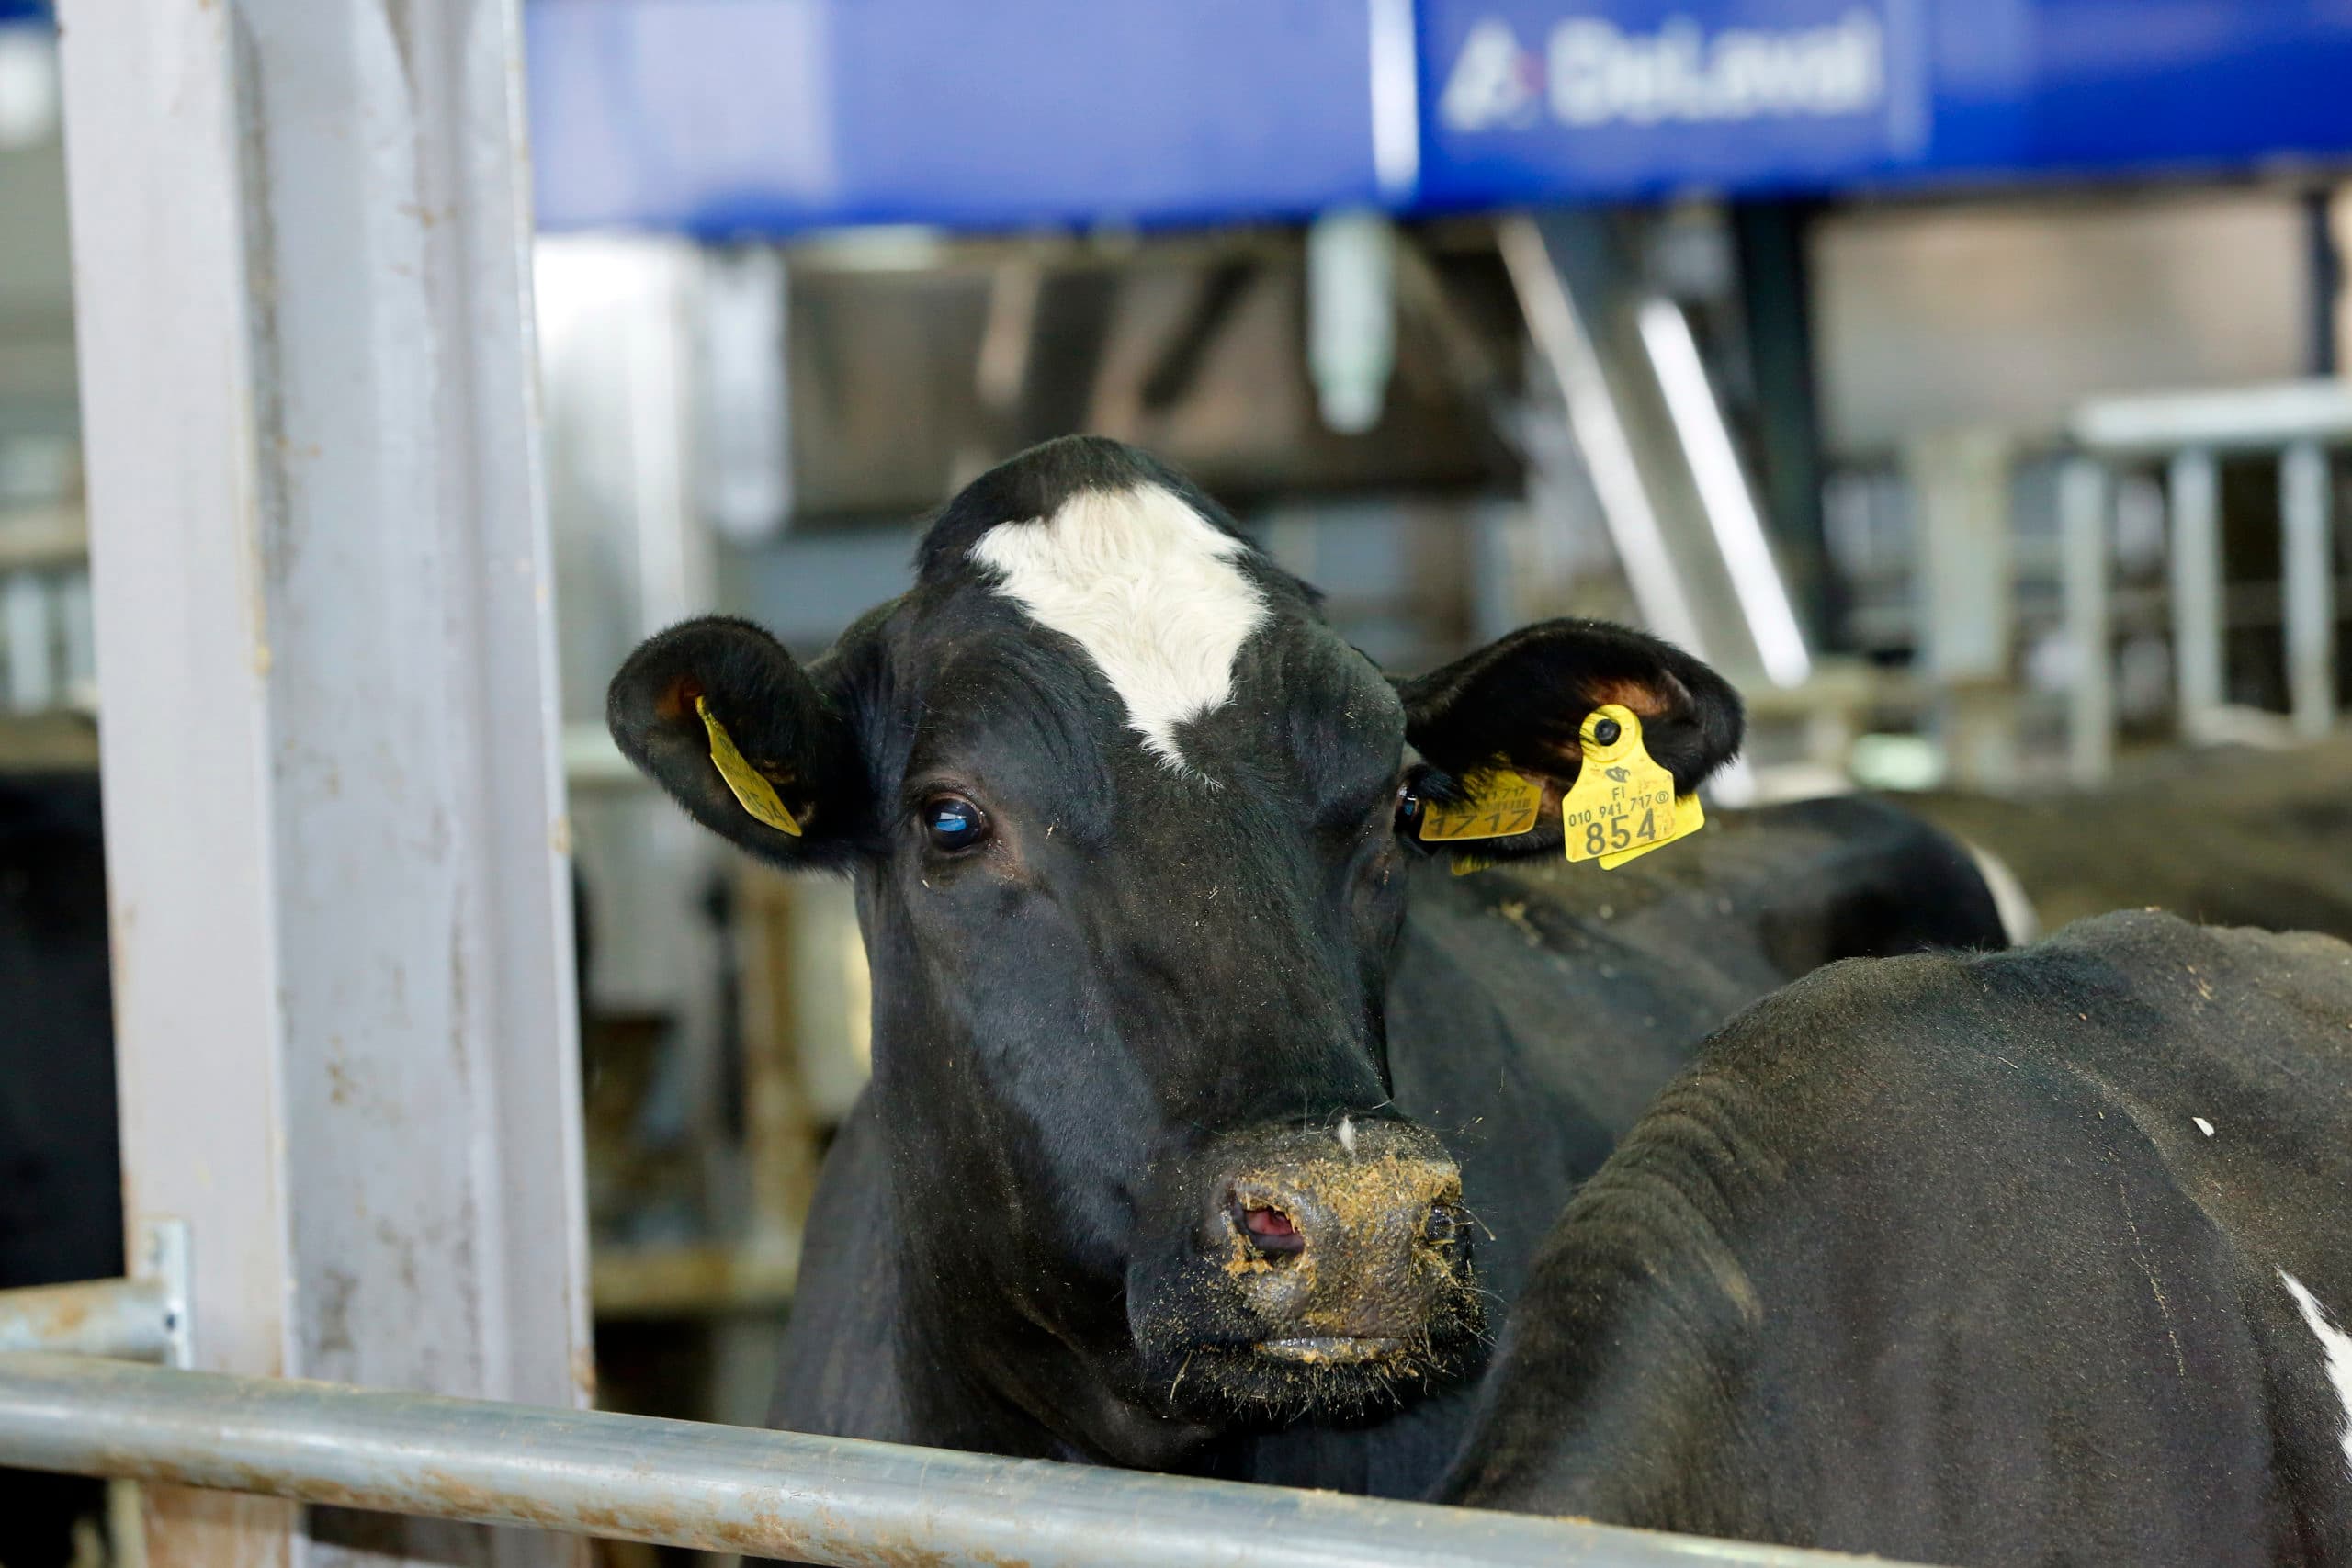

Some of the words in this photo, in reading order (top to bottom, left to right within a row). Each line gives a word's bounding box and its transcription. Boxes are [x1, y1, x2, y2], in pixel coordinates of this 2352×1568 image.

[1612, 786, 1624, 801] FI
[1429, 808, 1532, 836] 1717
[1568, 810, 1592, 827] 010
[1600, 802, 1622, 818] 941
[1630, 794, 1652, 811] 717
[1586, 808, 1656, 855] 854
